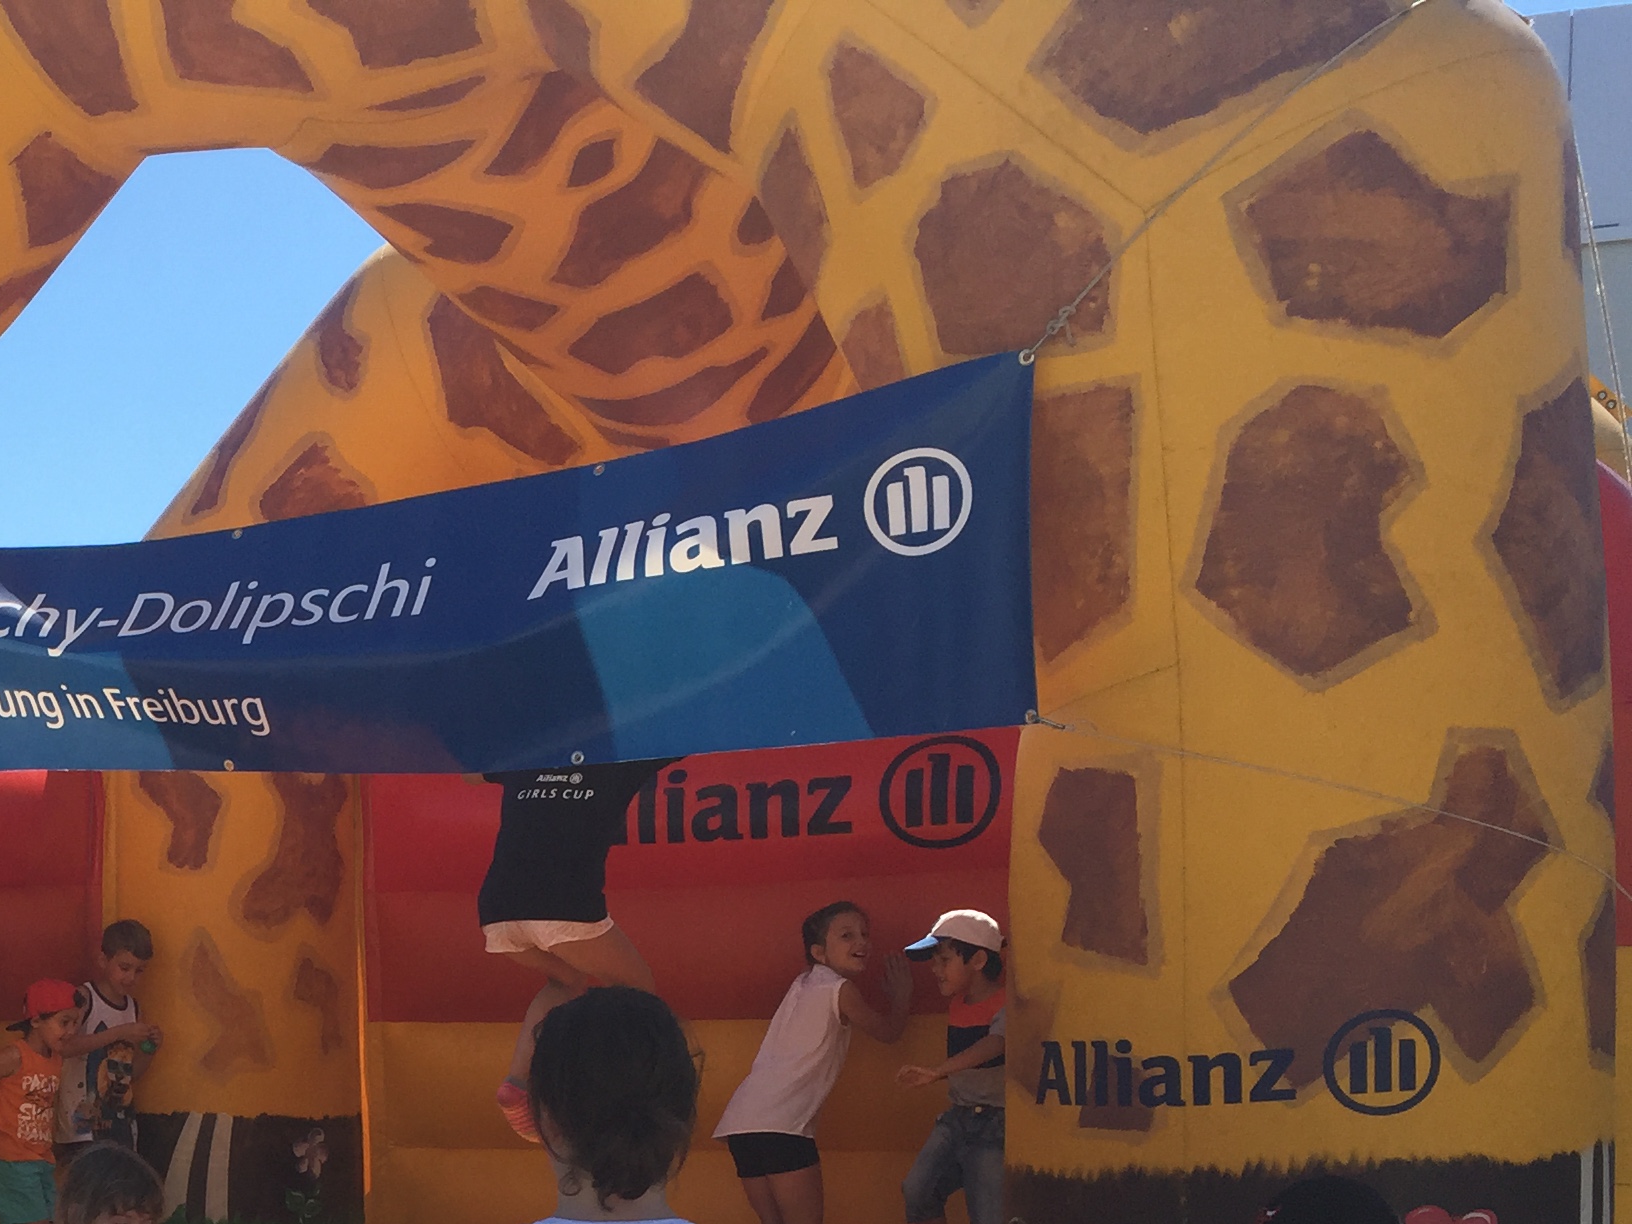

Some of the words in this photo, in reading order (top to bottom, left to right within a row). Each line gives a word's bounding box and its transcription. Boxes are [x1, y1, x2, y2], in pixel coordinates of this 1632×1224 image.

[526, 494, 838, 600] Allianz
[65, 684, 103, 721] in
[105, 687, 270, 737] Freiburg
[562, 788, 595, 800] CUP
[614, 768, 852, 846] lianz
[1035, 1039, 1297, 1107] Allianz
